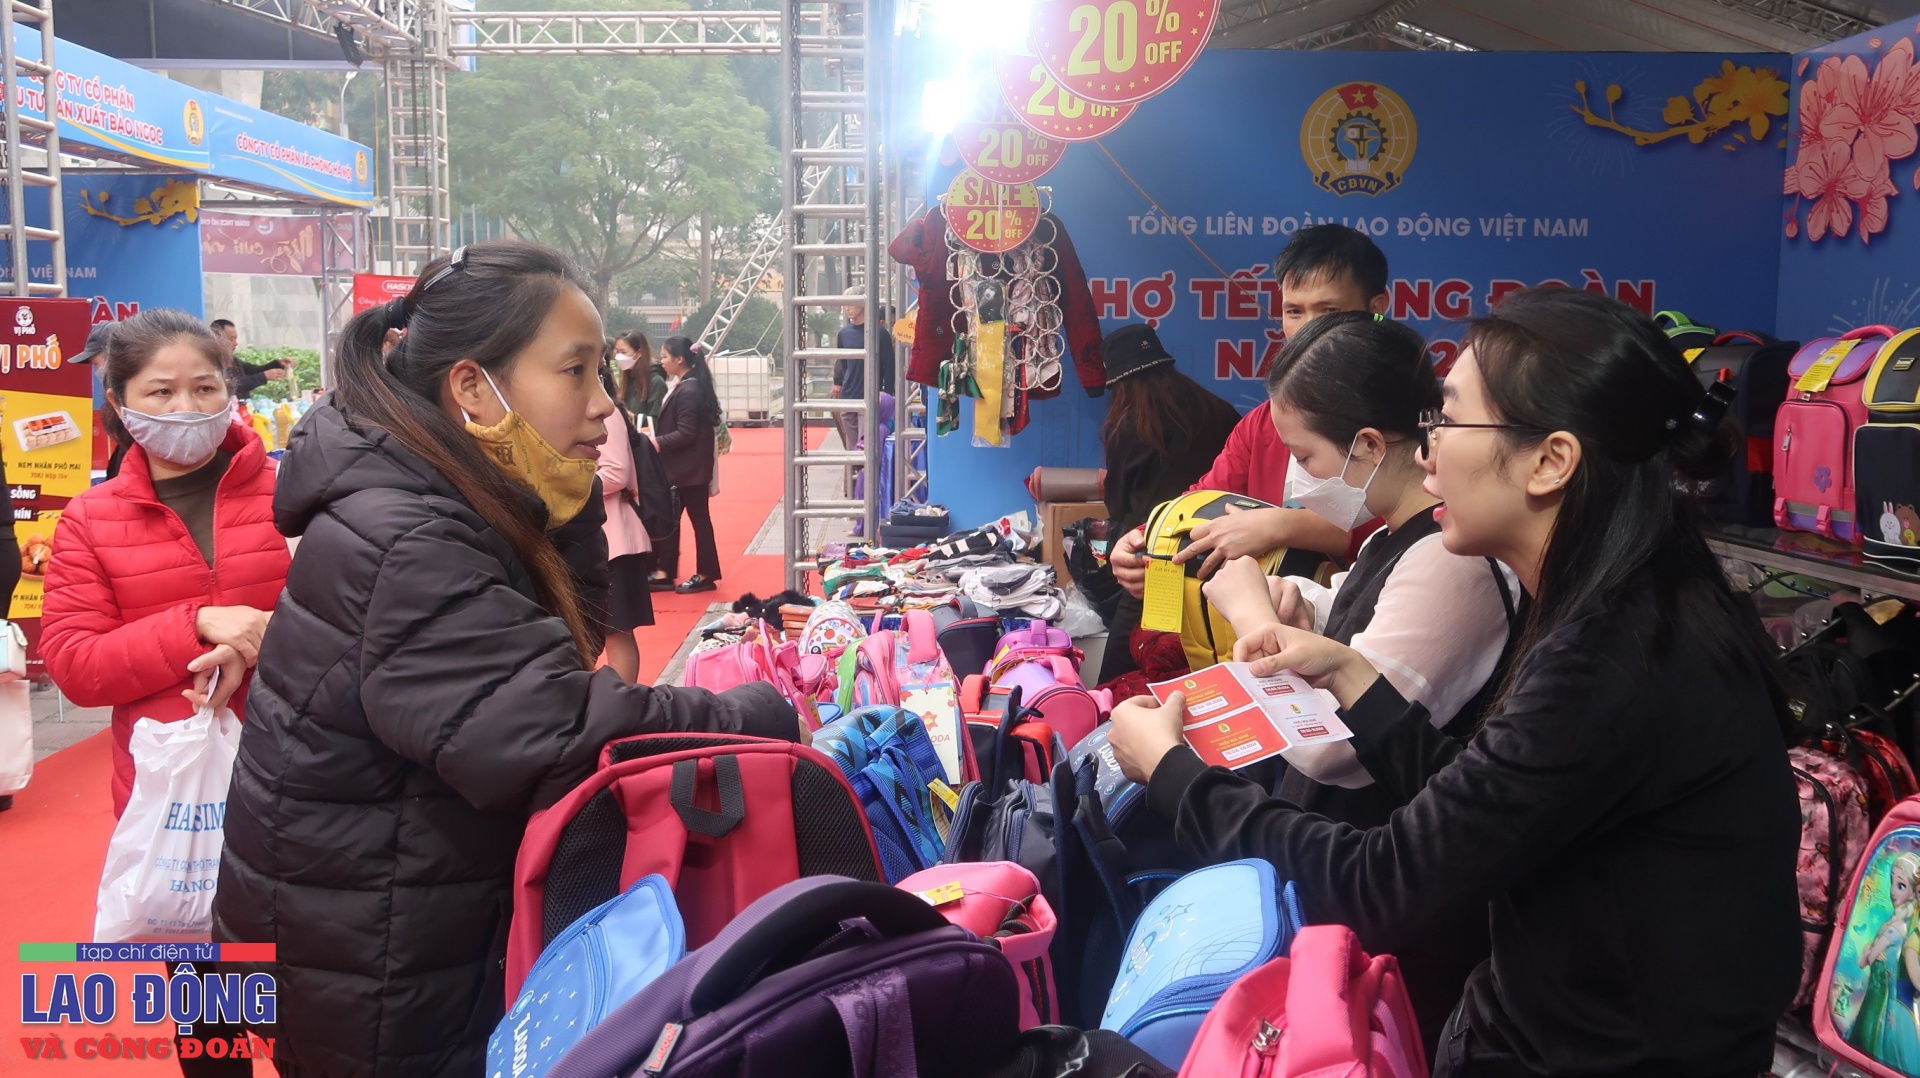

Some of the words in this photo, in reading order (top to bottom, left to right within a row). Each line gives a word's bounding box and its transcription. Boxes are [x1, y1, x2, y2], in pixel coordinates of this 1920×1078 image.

[1145, 41, 1182, 65] OFF
[66, 72, 83, 96] TY
[1090, 103, 1119, 117] OFF
[76, 103, 107, 129] XUẤT
[108, 110, 134, 136] BẢO
[135, 120, 163, 146] NGỌC
[237, 131, 259, 155] CÔNG
[259, 140, 270, 158] TY
[1026, 153, 1048, 167] OFF
[1337, 178, 1378, 191] CĐVN
[1128, 205, 1197, 236] TỔNG
[1206, 211, 1253, 235] LIÊN
[1397, 212, 1471, 241] ĐỘNG
[1479, 213, 1526, 242] VIỆT
[1534, 218, 1588, 237] NAM
[1005, 229, 1023, 239] OFF
[31, 264, 53, 281] VIỆ
[66, 267, 97, 279] NAM
[1088, 270, 1176, 329] HỢ
[1384, 279, 1473, 321] NG
[92, 296, 139, 326] ÀN
[16, 333, 62, 370] PHỐ
[34, 461, 52, 469] NHÂN
[10, 484, 36, 500] SỐNG
[14, 507, 32, 520] HÍN
[931, 735, 950, 743] ODA
[164, 802, 226, 832] HASIM
[169, 878, 218, 893] HANO
